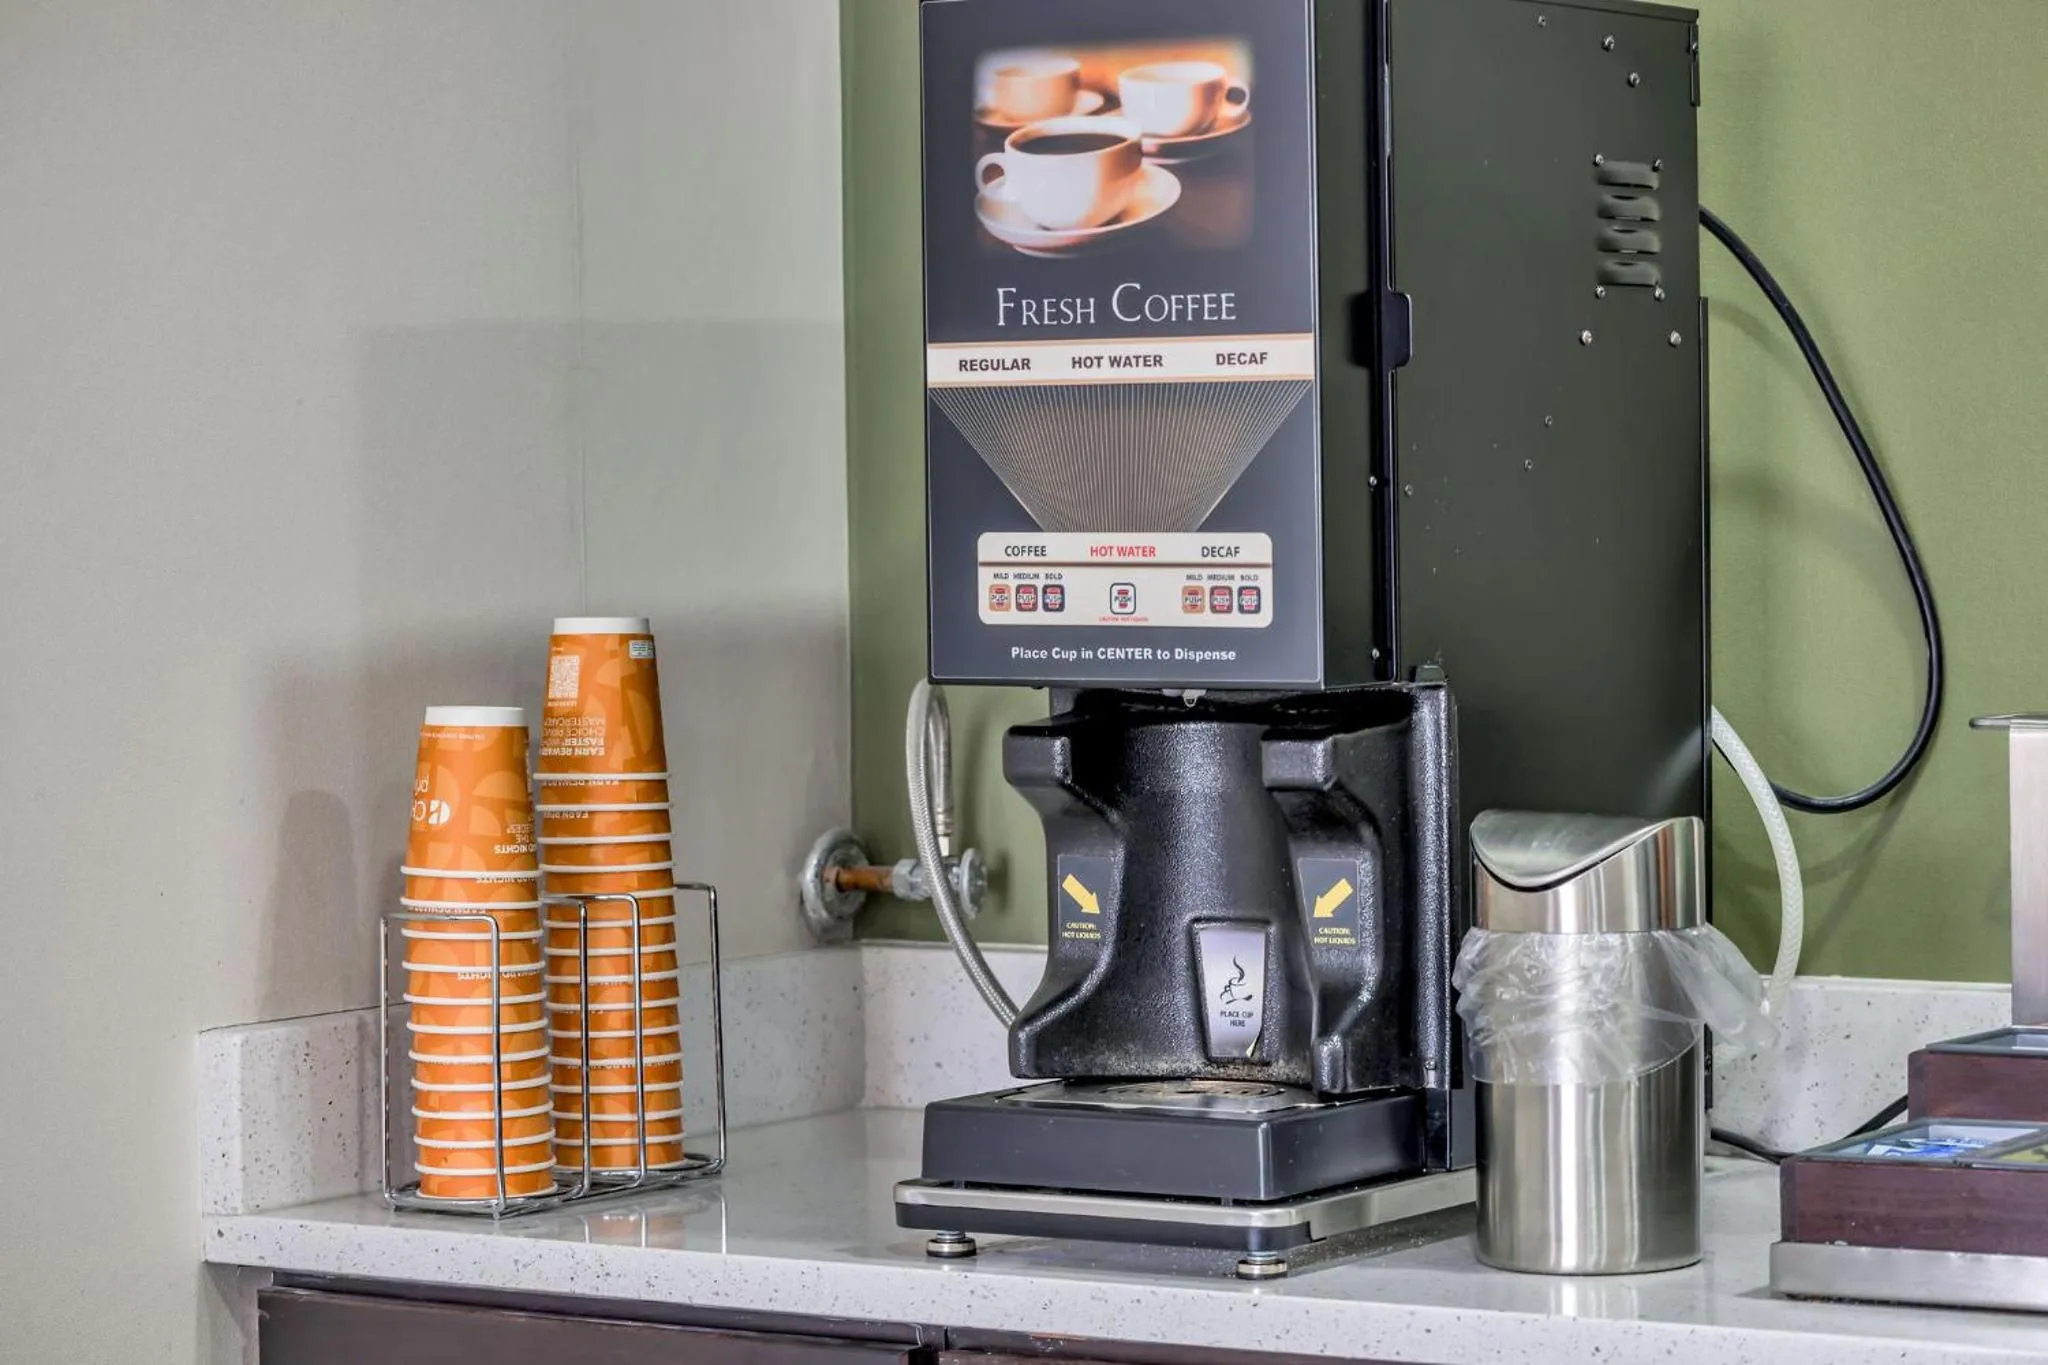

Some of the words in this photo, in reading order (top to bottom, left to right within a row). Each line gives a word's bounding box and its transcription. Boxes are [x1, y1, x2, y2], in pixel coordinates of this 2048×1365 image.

[995, 287, 1096, 327] FRESH
[1112, 282, 1237, 323] COFFEE
[958, 357, 1032, 372] REGULAR
[1071, 355, 1104, 370] HOT
[1108, 354, 1164, 369] WATER
[1215, 352, 1269, 366] DECAF
[1004, 545, 1047, 557] COFFEE
[1089, 545, 1114, 558] HOT
[1116, 545, 1157, 558] WATER
[1200, 546, 1241, 558] DECAF
[1010, 646, 1048, 660] Place
[1051, 646, 1077, 662] Cup
[1081, 647, 1093, 660] in
[1096, 647, 1153, 660] CENTER
[1157, 648, 1170, 661] to
[1174, 647, 1237, 664] Dispense
